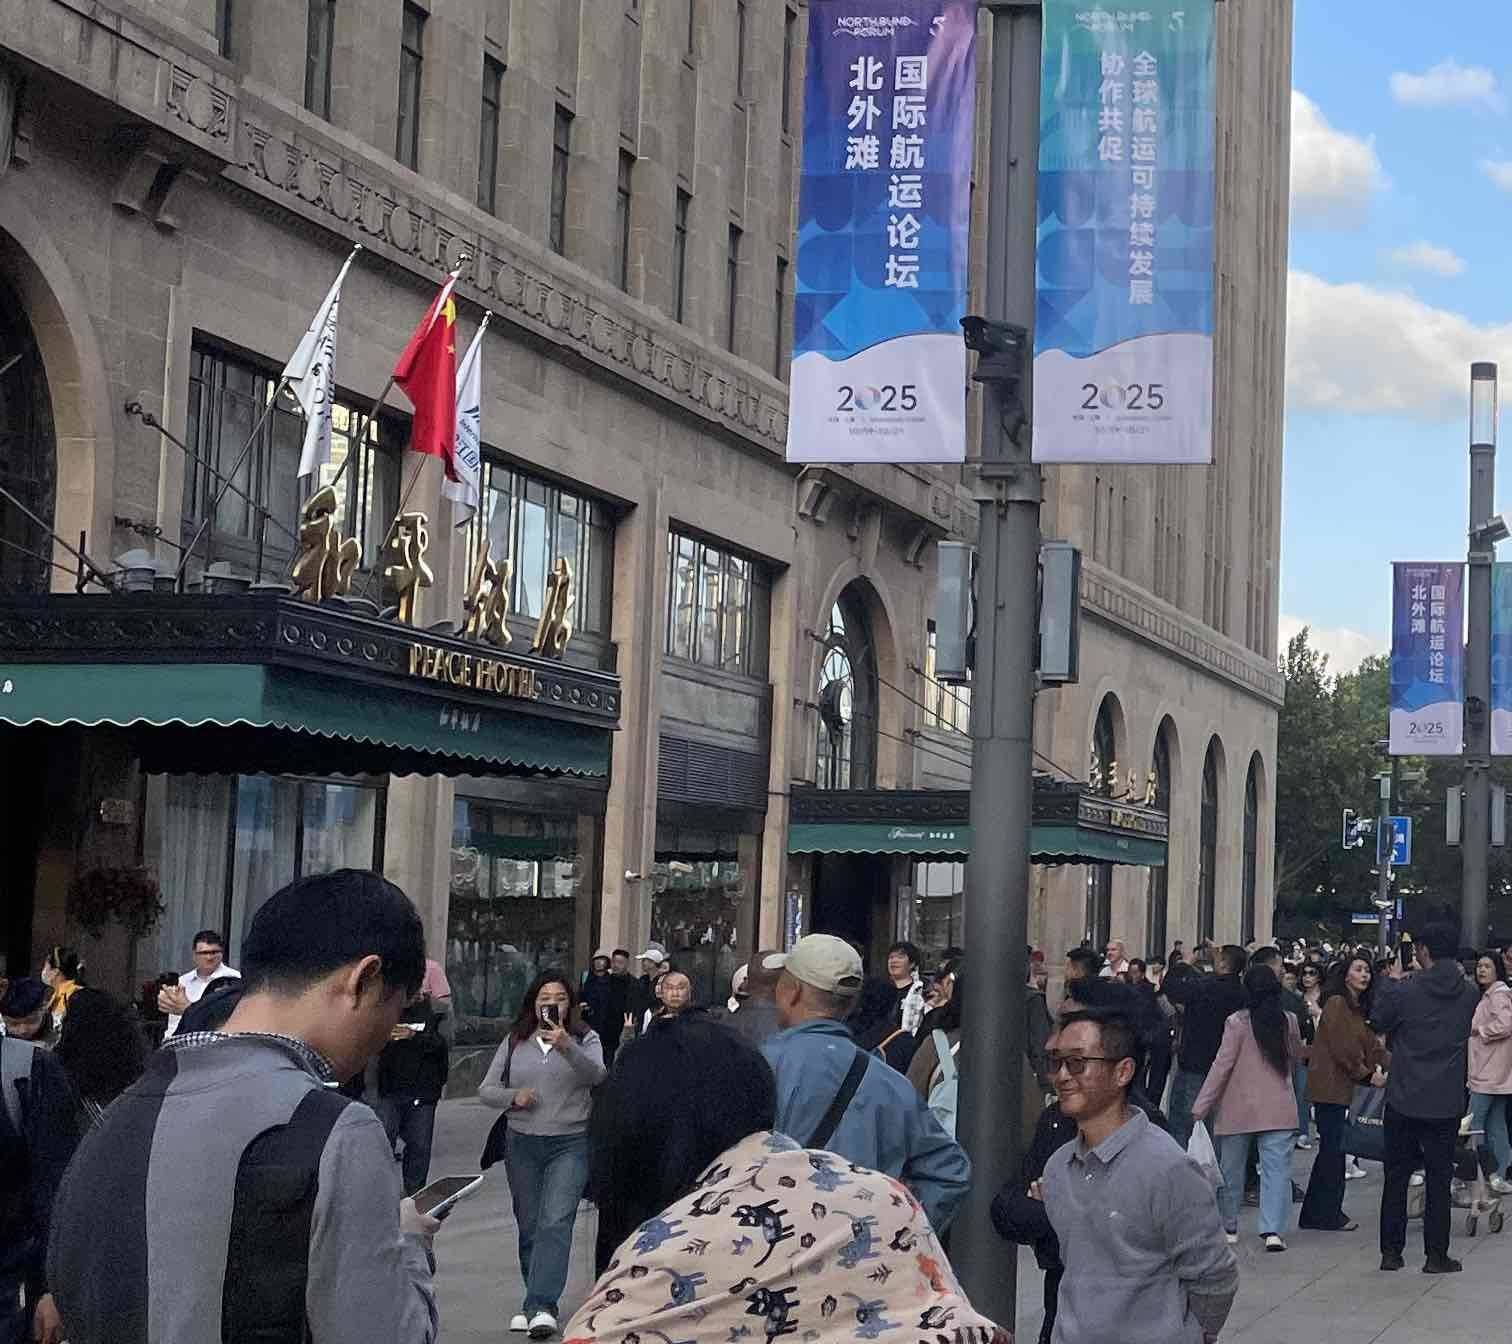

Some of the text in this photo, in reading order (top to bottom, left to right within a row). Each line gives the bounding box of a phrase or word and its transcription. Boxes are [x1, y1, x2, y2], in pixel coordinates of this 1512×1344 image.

[845, 56, 884, 170] 北外滩
[884, 55, 929, 289] 国际航运论坛
[836, 384, 918, 412] 2025
[1080, 383, 1164, 410] 2025
[1410, 583, 1428, 634] 北外滩
[409, 642, 472, 687] PEACE
